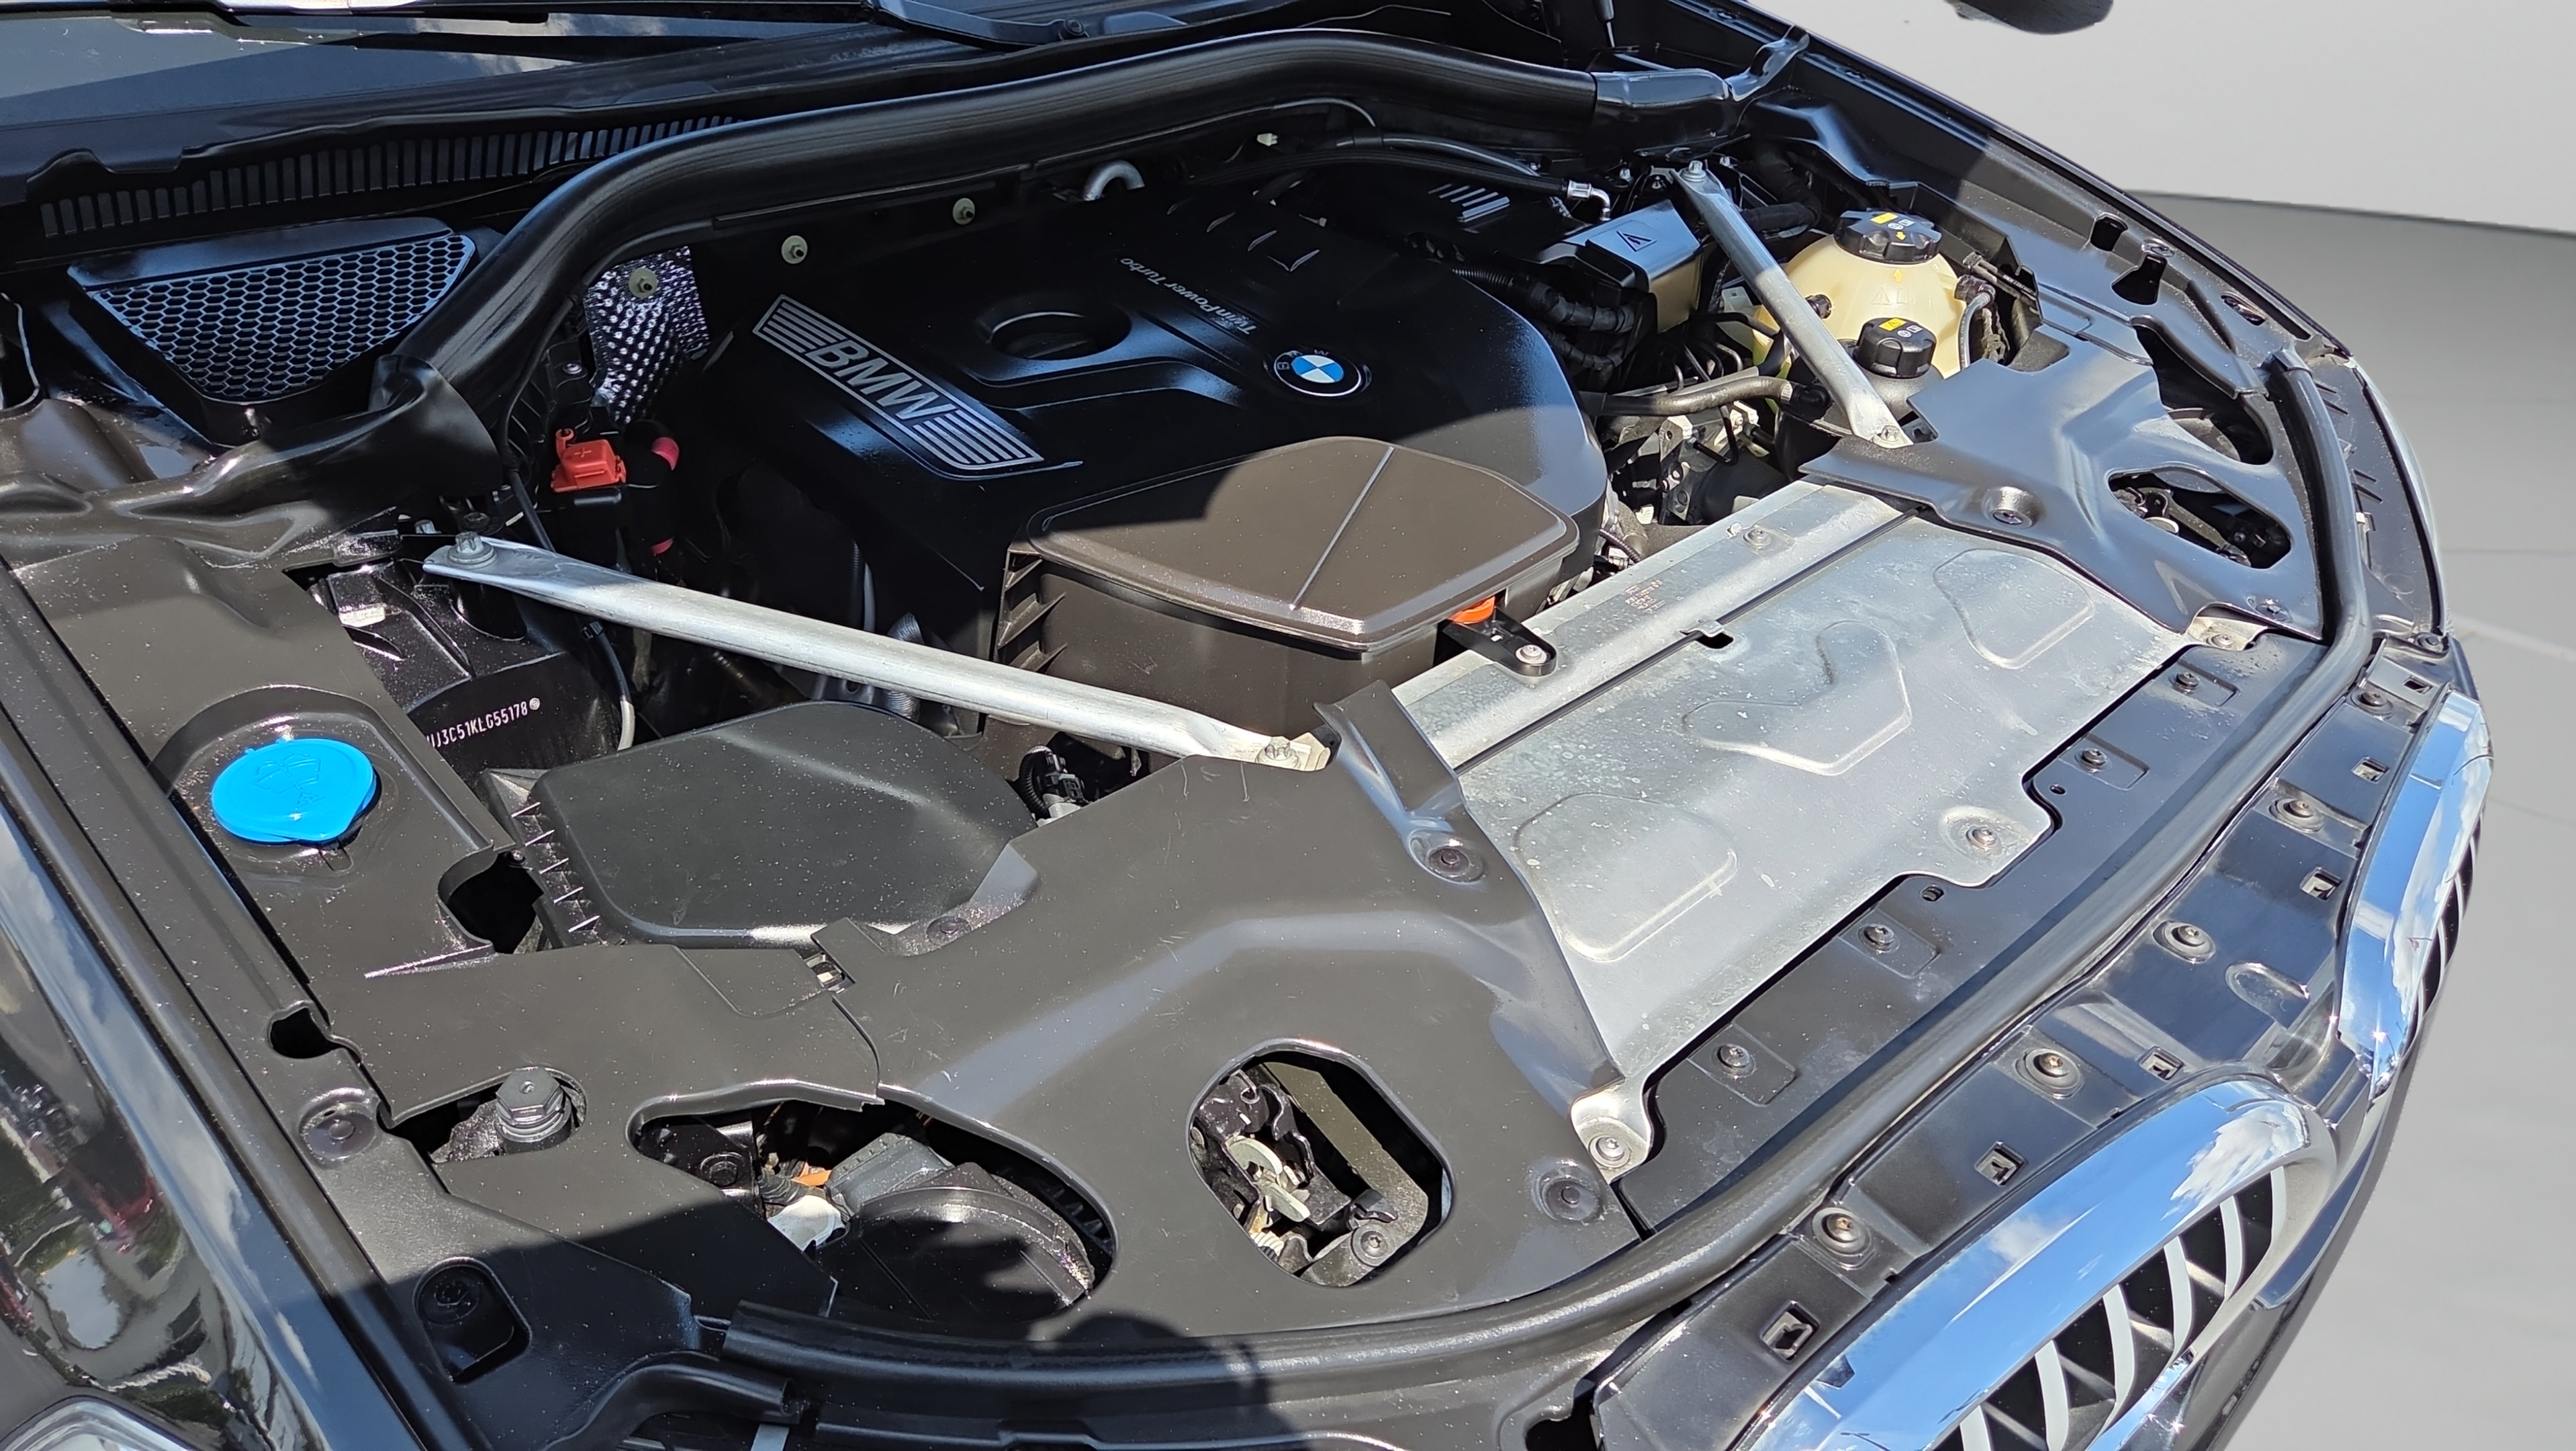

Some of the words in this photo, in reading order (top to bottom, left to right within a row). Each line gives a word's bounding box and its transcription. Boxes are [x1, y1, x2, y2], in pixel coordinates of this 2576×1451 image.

[1120, 257, 1166, 285] Turbo
[1164, 283, 1257, 335] TwinPower
[805, 339, 958, 420] BMW
